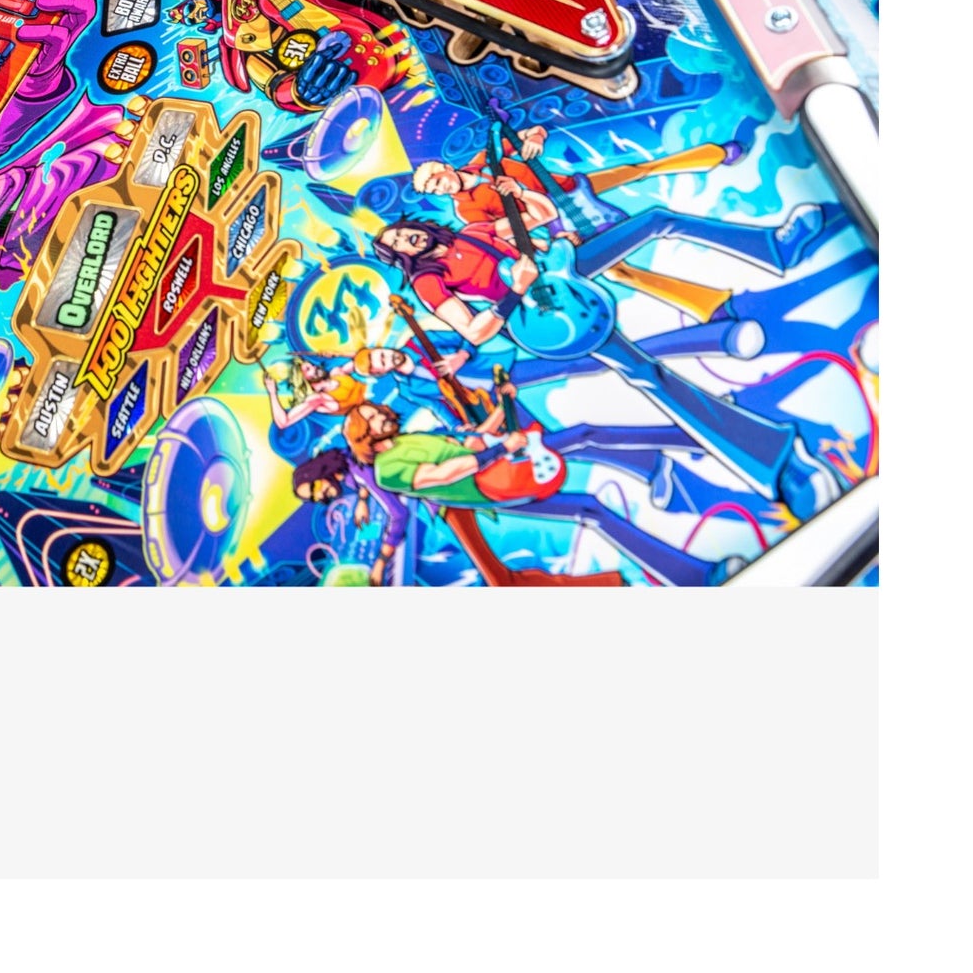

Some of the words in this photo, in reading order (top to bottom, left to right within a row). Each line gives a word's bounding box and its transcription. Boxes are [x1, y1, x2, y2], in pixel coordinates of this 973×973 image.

[107, 52, 129, 80] EXTRA
[120, 56, 146, 83] BALL
[153, 134, 176, 164] D.C.
[211, 178, 226, 197] LOS
[220, 137, 242, 176] ANGELES
[112, 166, 200, 330] FIGHTERS
[232, 205, 260, 259] CHICAGO
[57, 212, 115, 327] OVERLORD
[162, 255, 193, 314] ROSWELL
[252, 303, 267, 328] NEW
[261, 271, 281, 304] YORK
[180, 369, 195, 391] NEW
[188, 322, 213, 368] ORLEANS
[33, 371, 70, 437] AUSTIN
[110, 382, 141, 440] SEATTLE
[74, 549, 101, 581] 2X
